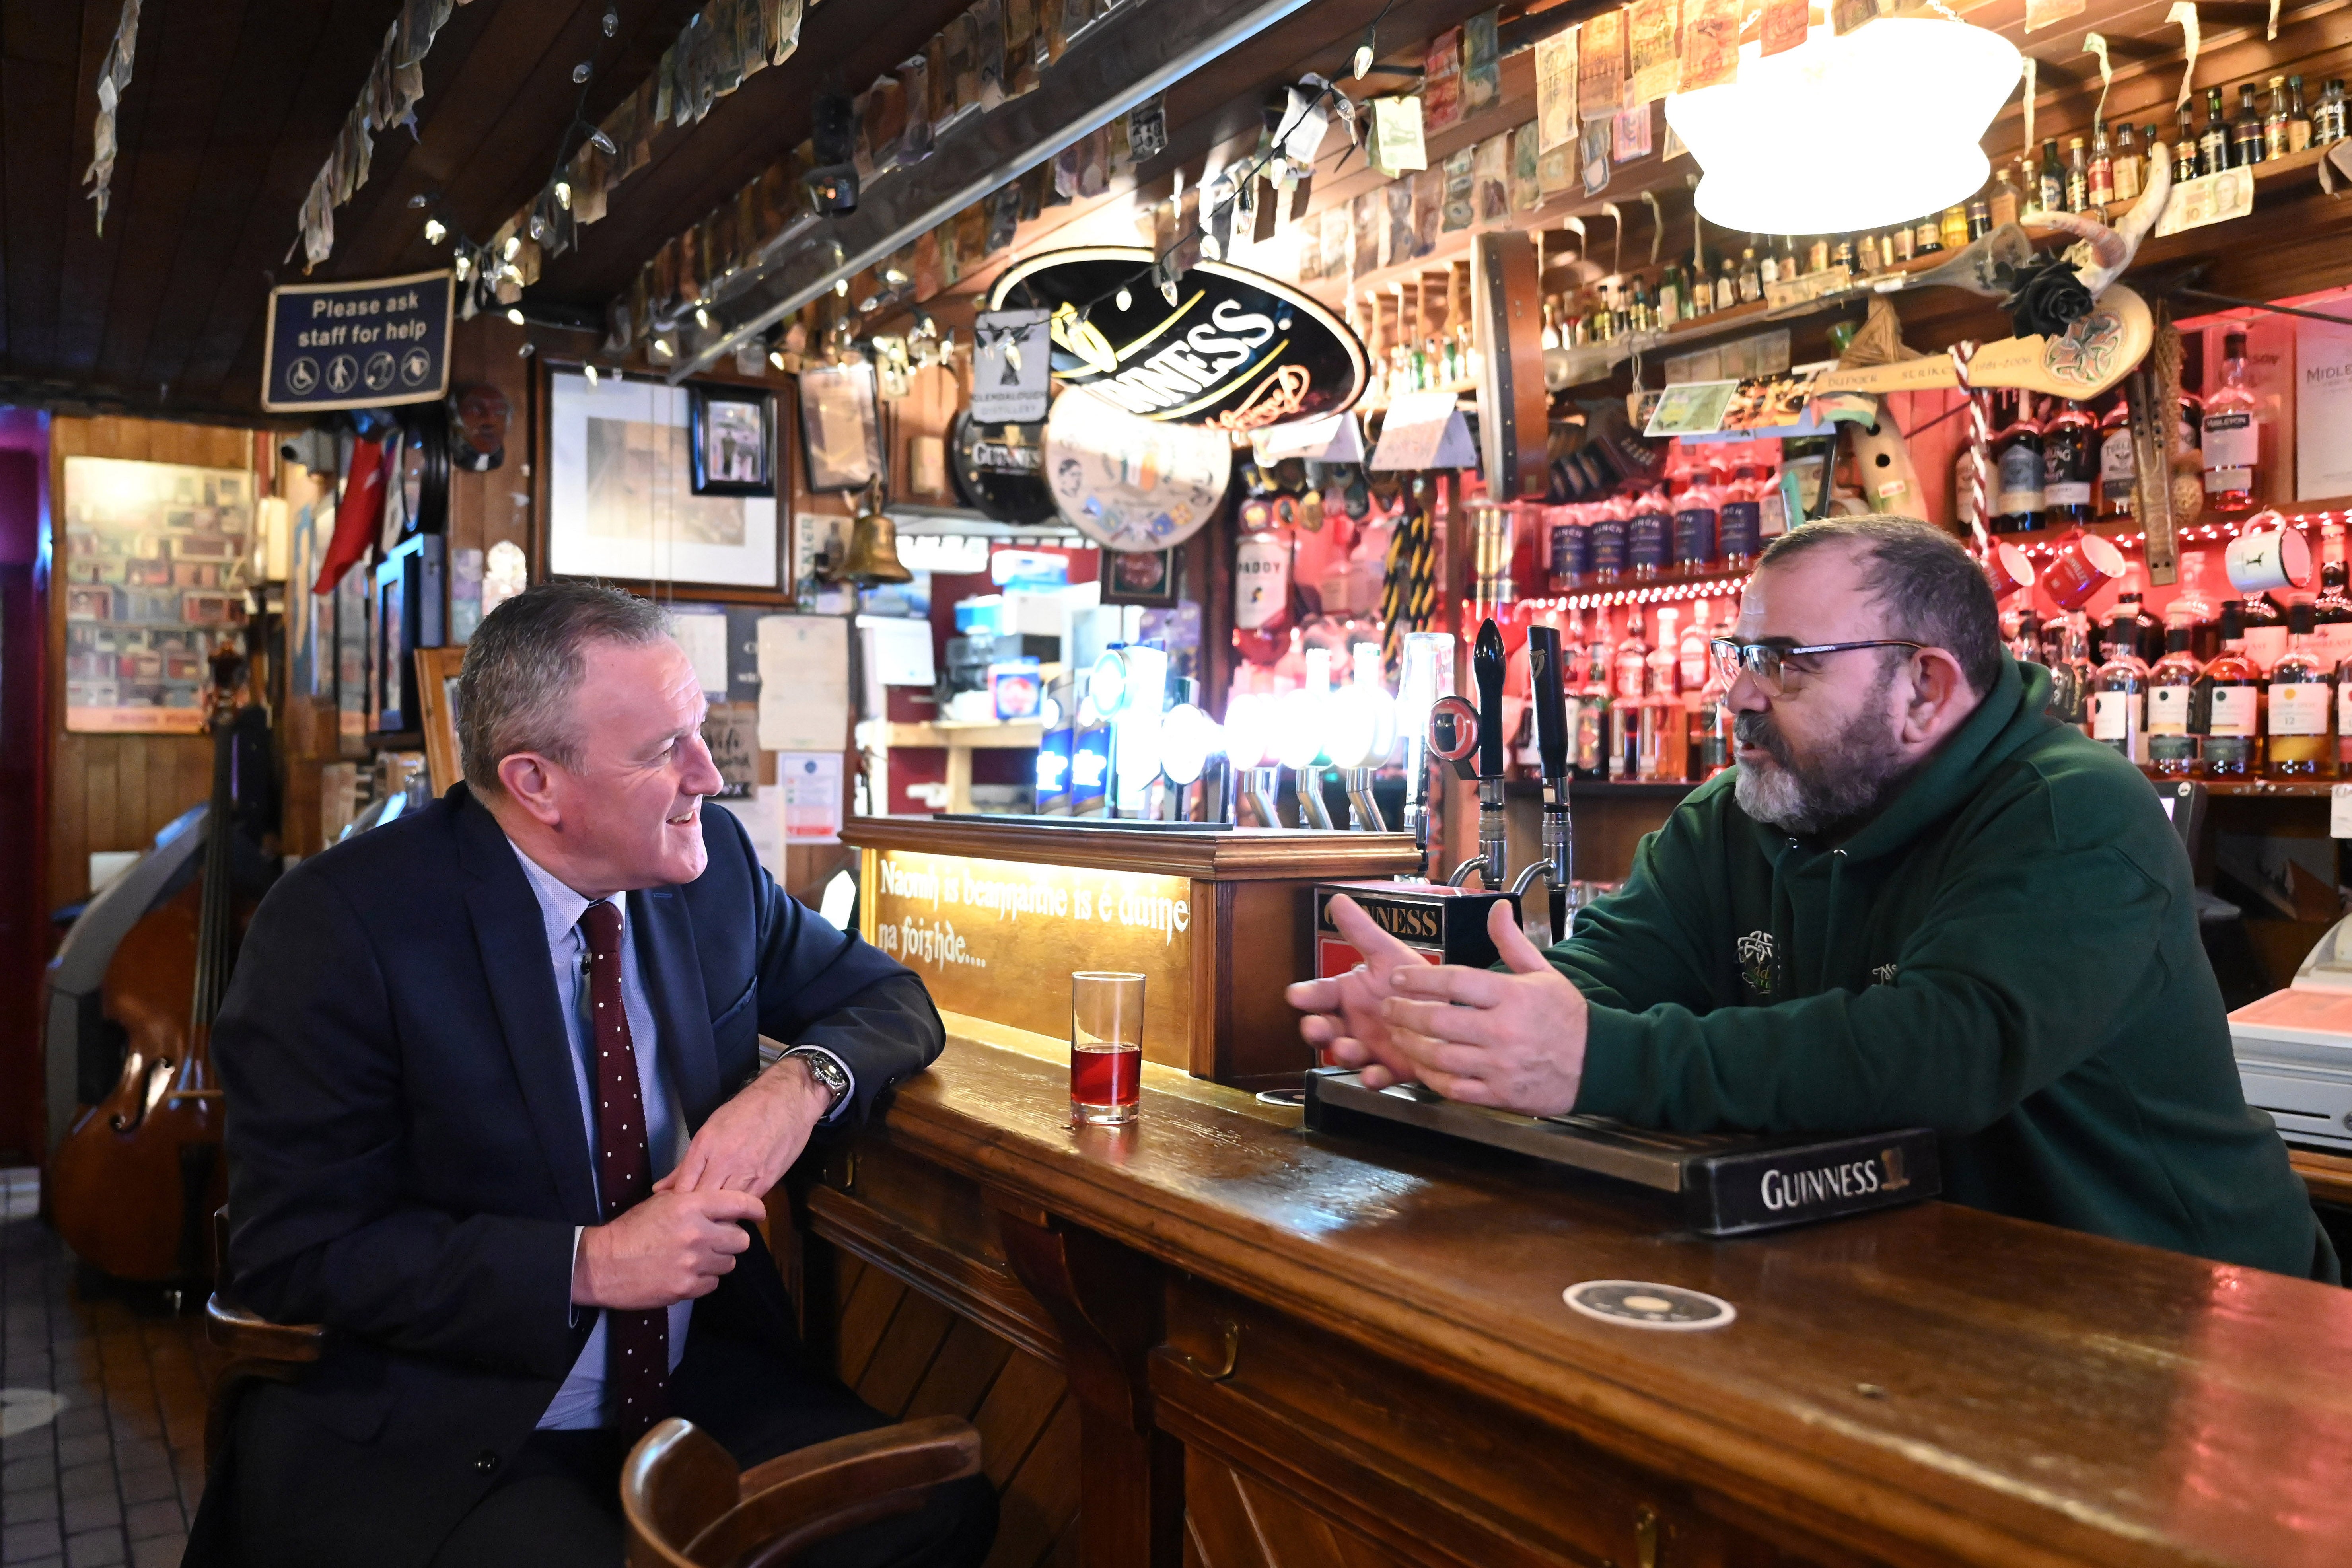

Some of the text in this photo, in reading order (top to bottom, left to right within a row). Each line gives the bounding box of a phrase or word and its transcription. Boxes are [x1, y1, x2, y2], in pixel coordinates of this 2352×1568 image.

[312, 290, 418, 319] Please ask
[298, 318, 427, 348] staff for help
[880, 858, 939, 912] Naomh
[944, 865, 959, 903] is
[1073, 876, 1093, 920] is
[1098, 880, 1113, 922] é
[1118, 877, 1190, 947] duine
[879, 923, 897, 953] na
[1761, 1159, 1879, 1211] GUINNESS
